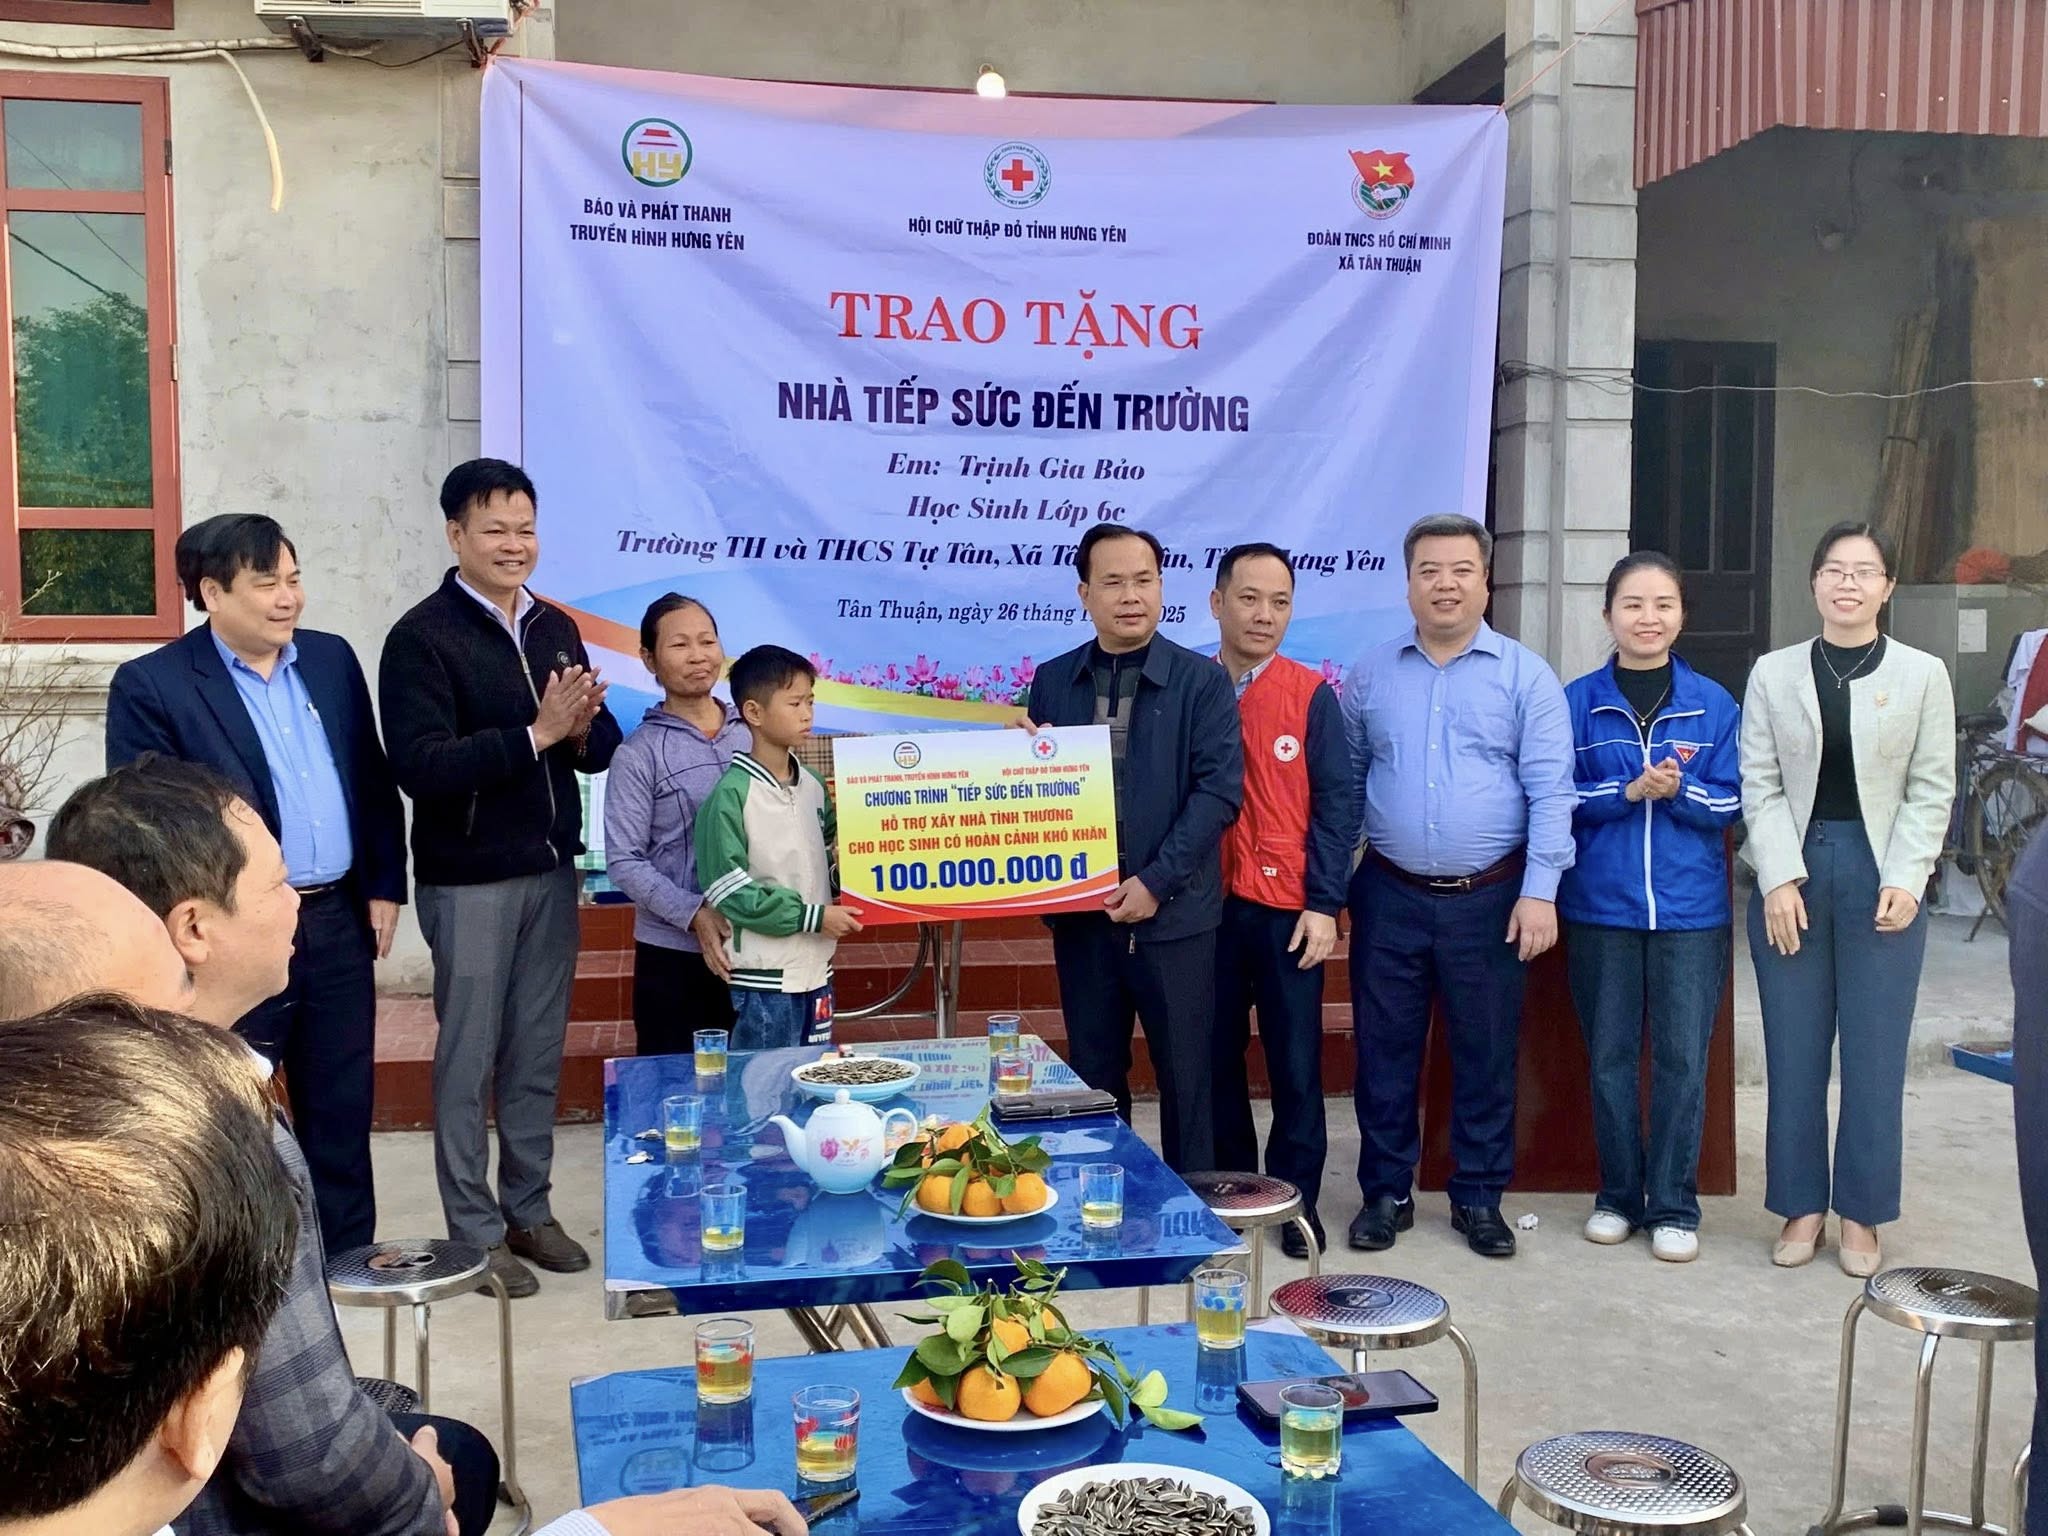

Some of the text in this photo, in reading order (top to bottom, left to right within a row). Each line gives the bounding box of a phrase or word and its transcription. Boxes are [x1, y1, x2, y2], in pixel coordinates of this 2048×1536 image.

[583, 197, 731, 223] BÁO VÀ PHÁT THANH
[631, 227, 667, 248] HÌNH
[671, 230, 712, 249] HƯNG
[716, 230, 744, 250] YÊN
[908, 216, 1127, 243] HỘI CHỮ THẬP ĐỎ TỈNH HƯNG YÊN
[1307, 229, 1341, 246] ĐOÀN
[1344, 232, 1376, 248] TNCS
[1398, 232, 1417, 250] CHÍ
[1419, 235, 1452, 250] MINH
[1338, 253, 1422, 275] XÃ TÂN THUẬN
[829, 288, 1204, 360] TRAO TẶNG
[778, 374, 1250, 432] NHÀ TIẾP SỨC ĐẾN TRƯỜNG
[887, 452, 1146, 485] Em: Trịnh Gia Bảo
[907, 495, 1126, 528] Học Sinh Lớp 6c
[617, 529, 1386, 577] Trường TH và THCS Tự Tân, Xã Tâ ưng Yên
[837, 598, 872, 618] Tân
[878, 599, 943, 624] Thuận,
[948, 601, 993, 625] ngày
[996, 602, 1019, 621] 26
[1022, 603, 1077, 626] tháng
[864, 789, 912, 808] CHƯƠNG
[914, 785, 948, 805] TRÌNH
[985, 781, 1008, 801] SỨC
[1010, 779, 1033, 800] ĐẾN
[902, 815, 927, 832] TRỢ
[931, 812, 956, 829] XÂY
[960, 810, 987, 827] NHÀ
[989, 809, 1019, 826] TÌNH
[1022, 808, 1074, 824] THƯƠNG
[848, 825, 1107, 856] CHO HỌC SINH CÓ HOÀN CẢNH KHÓ KHĂN
[870, 851, 1088, 893] 100.000.000 đ
